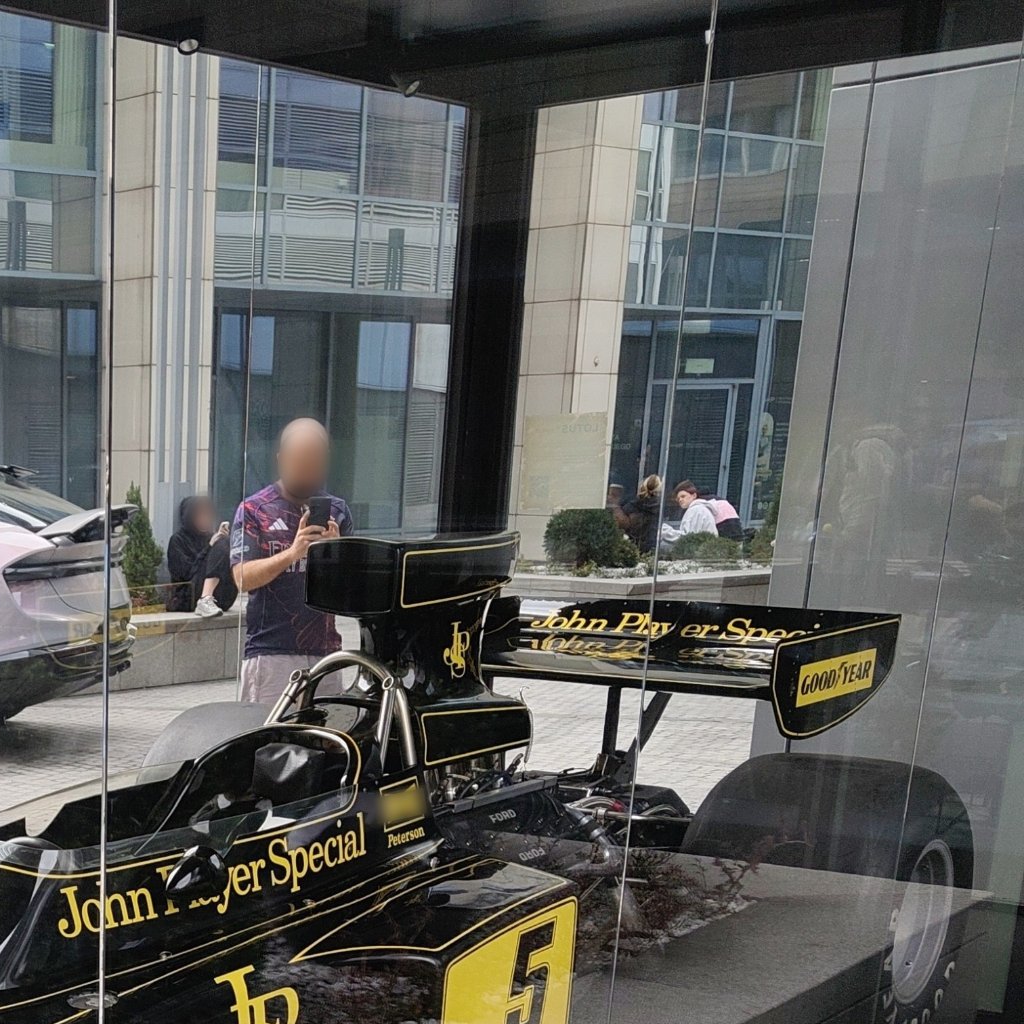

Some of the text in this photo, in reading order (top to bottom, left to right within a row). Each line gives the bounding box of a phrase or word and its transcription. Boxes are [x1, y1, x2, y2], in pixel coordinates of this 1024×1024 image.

[530, 609, 608, 632] John
[718, 617, 821, 646] Spec
[800, 660, 873, 696] GOODYEAR
[488, 808, 517, 824] FORD
[267, 811, 367, 893] Special
[387, 826, 426, 849] Peterson
